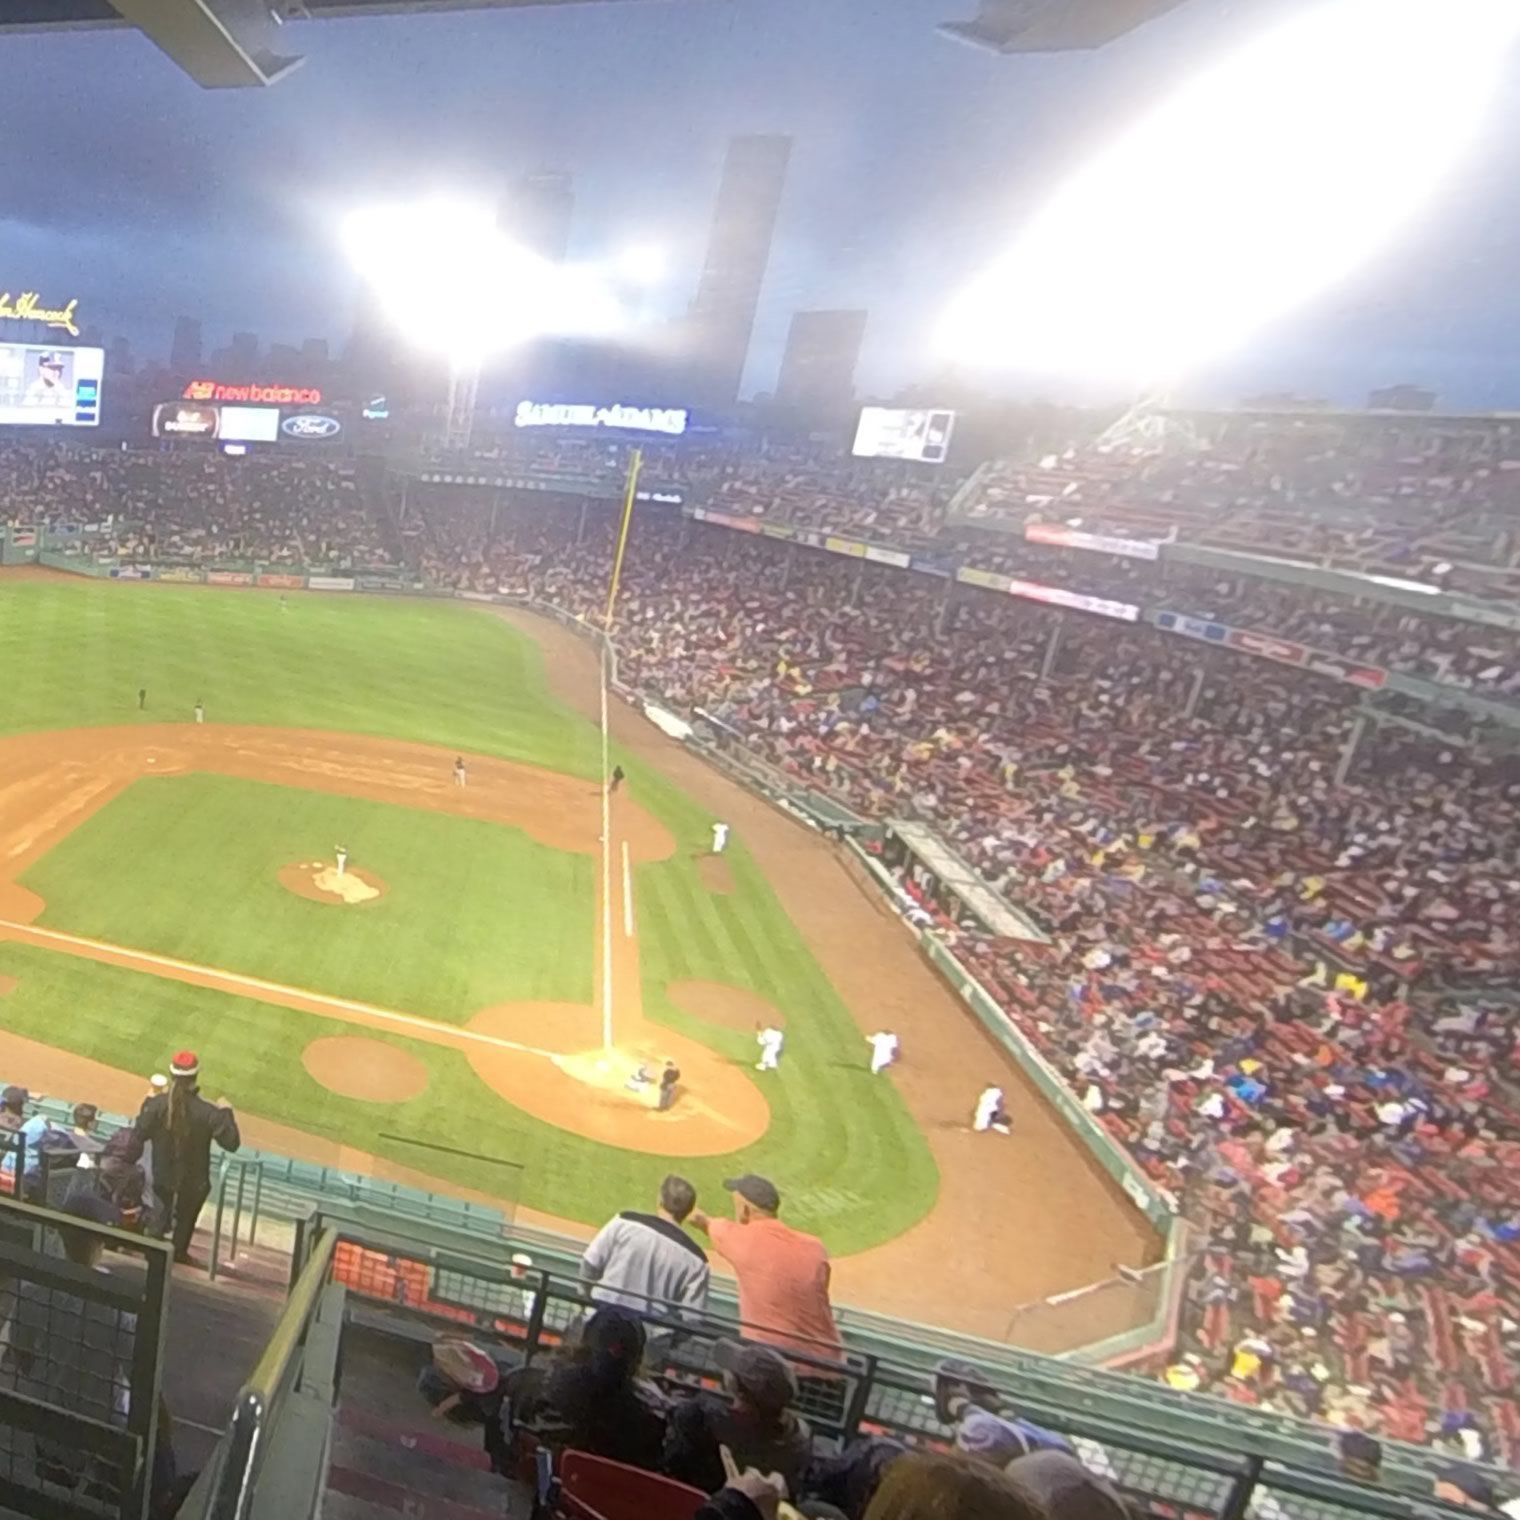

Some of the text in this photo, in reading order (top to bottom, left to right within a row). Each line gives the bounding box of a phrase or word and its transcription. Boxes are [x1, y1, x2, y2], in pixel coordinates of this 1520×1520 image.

[16, 291, 80, 337] Hancock
[215, 383, 321, 404] new balance
[293, 418, 329, 434] Ford
